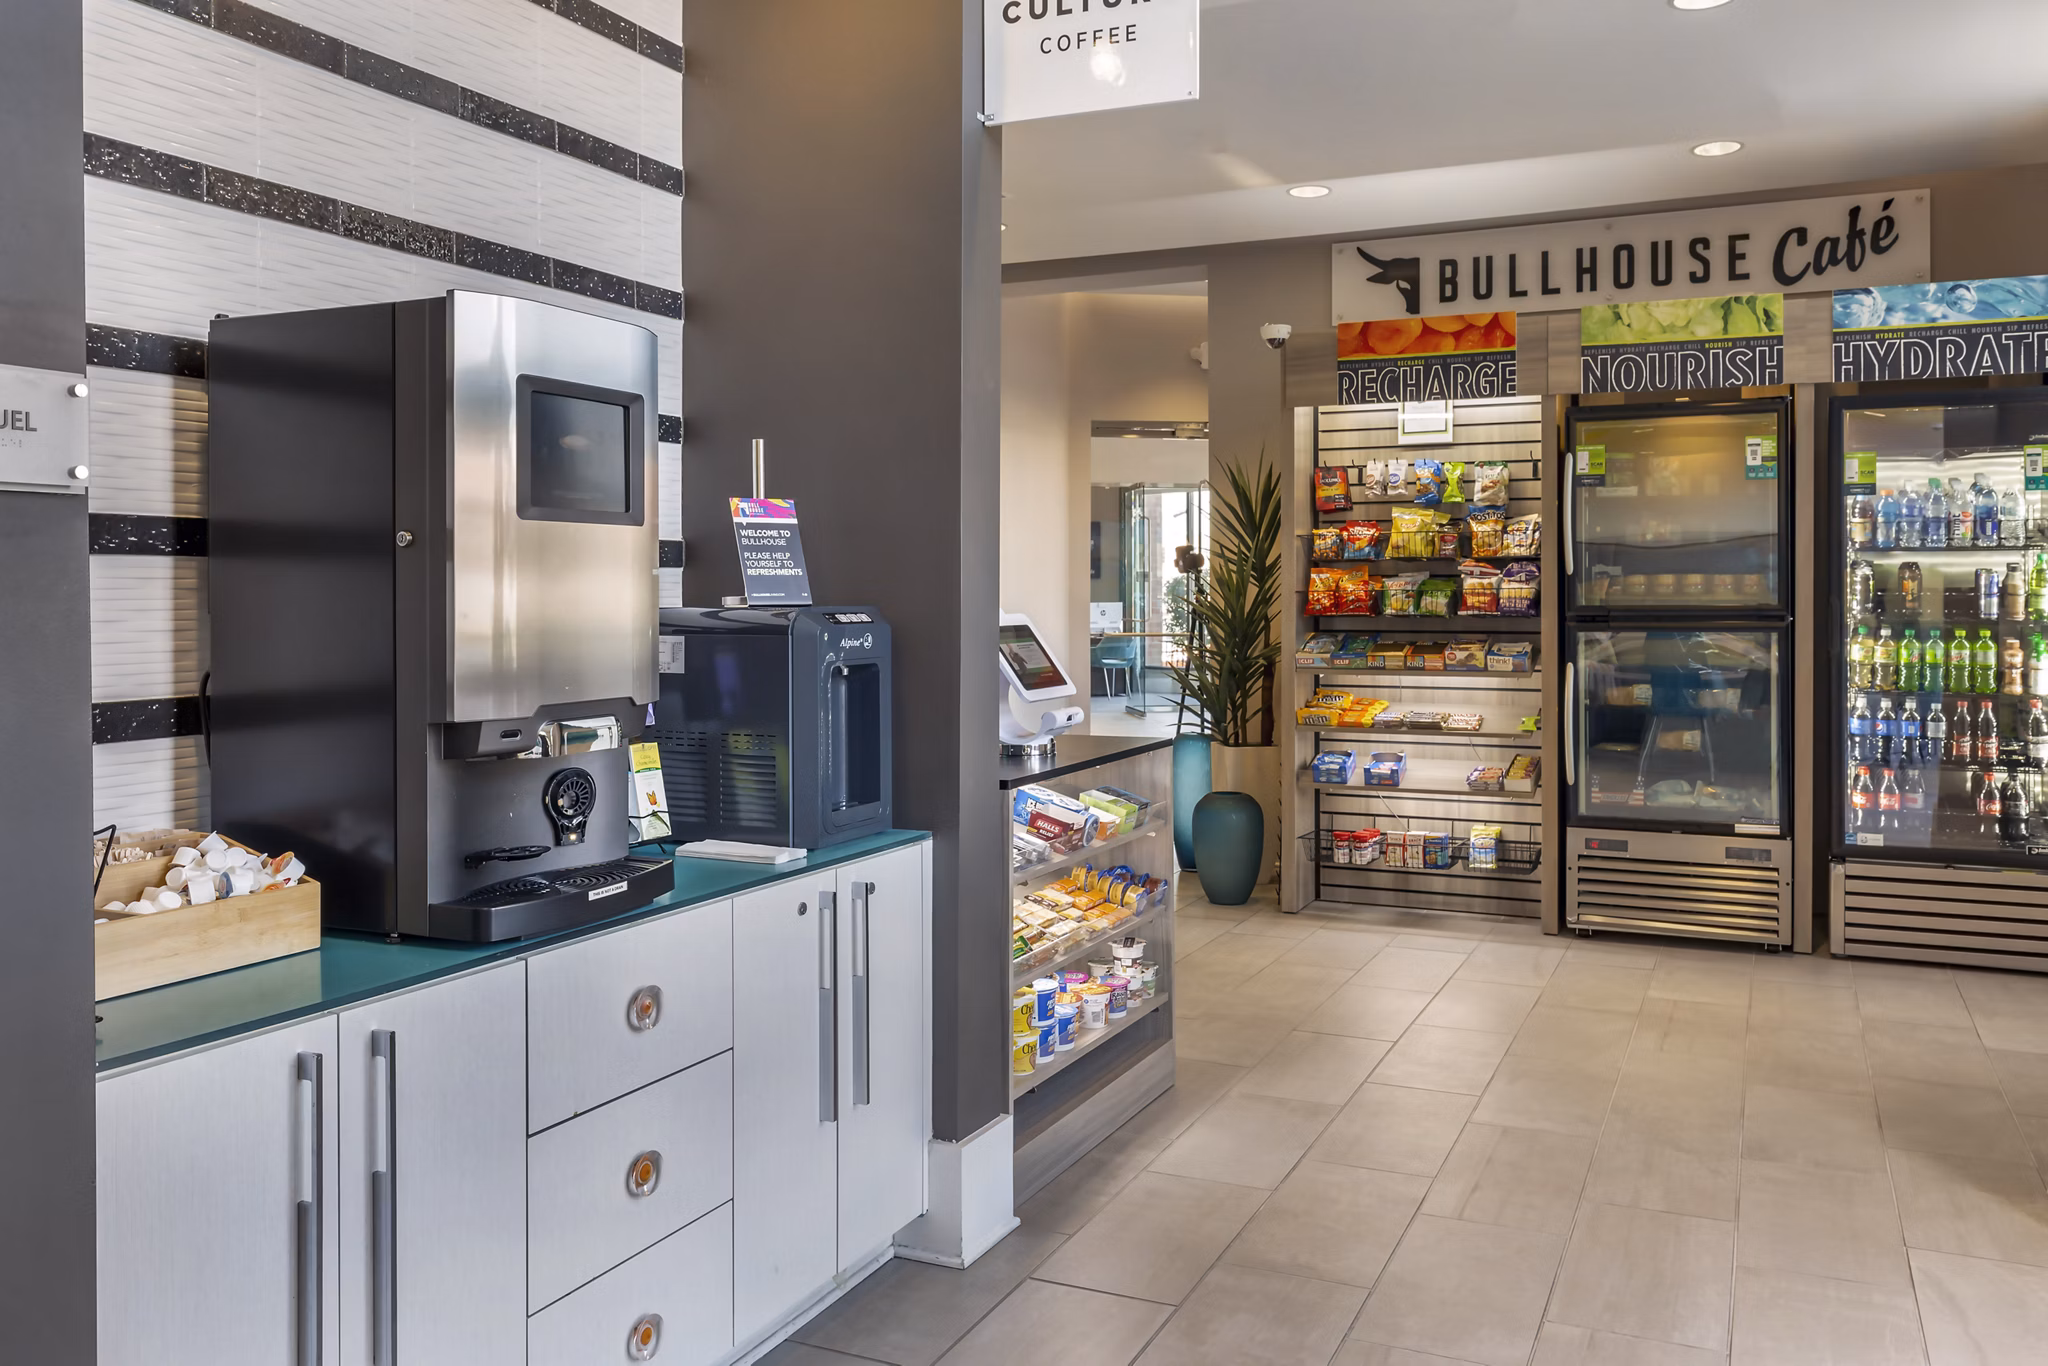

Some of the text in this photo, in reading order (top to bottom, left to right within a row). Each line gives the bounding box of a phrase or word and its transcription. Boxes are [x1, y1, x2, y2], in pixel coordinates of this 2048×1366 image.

[1040, 24, 1137, 54] COFFEE
[1439, 197, 1899, 304] BULLHOUSE Café
[1875, 331, 1905, 339] HYDRATE
[1909, 329, 1943, 337] RECHARGE
[1704, 341, 1732, 349] NOURISH
[1580, 346, 1784, 394] NOURISH
[1338, 361, 1517, 405] RECHARGE
[1472, 511, 1505, 521] TOSTITOS
[740, 529, 779, 537] WELCOME
[747, 568, 803, 576] REFRESHMENTS
[1037, 821, 1060, 833] HALLS
